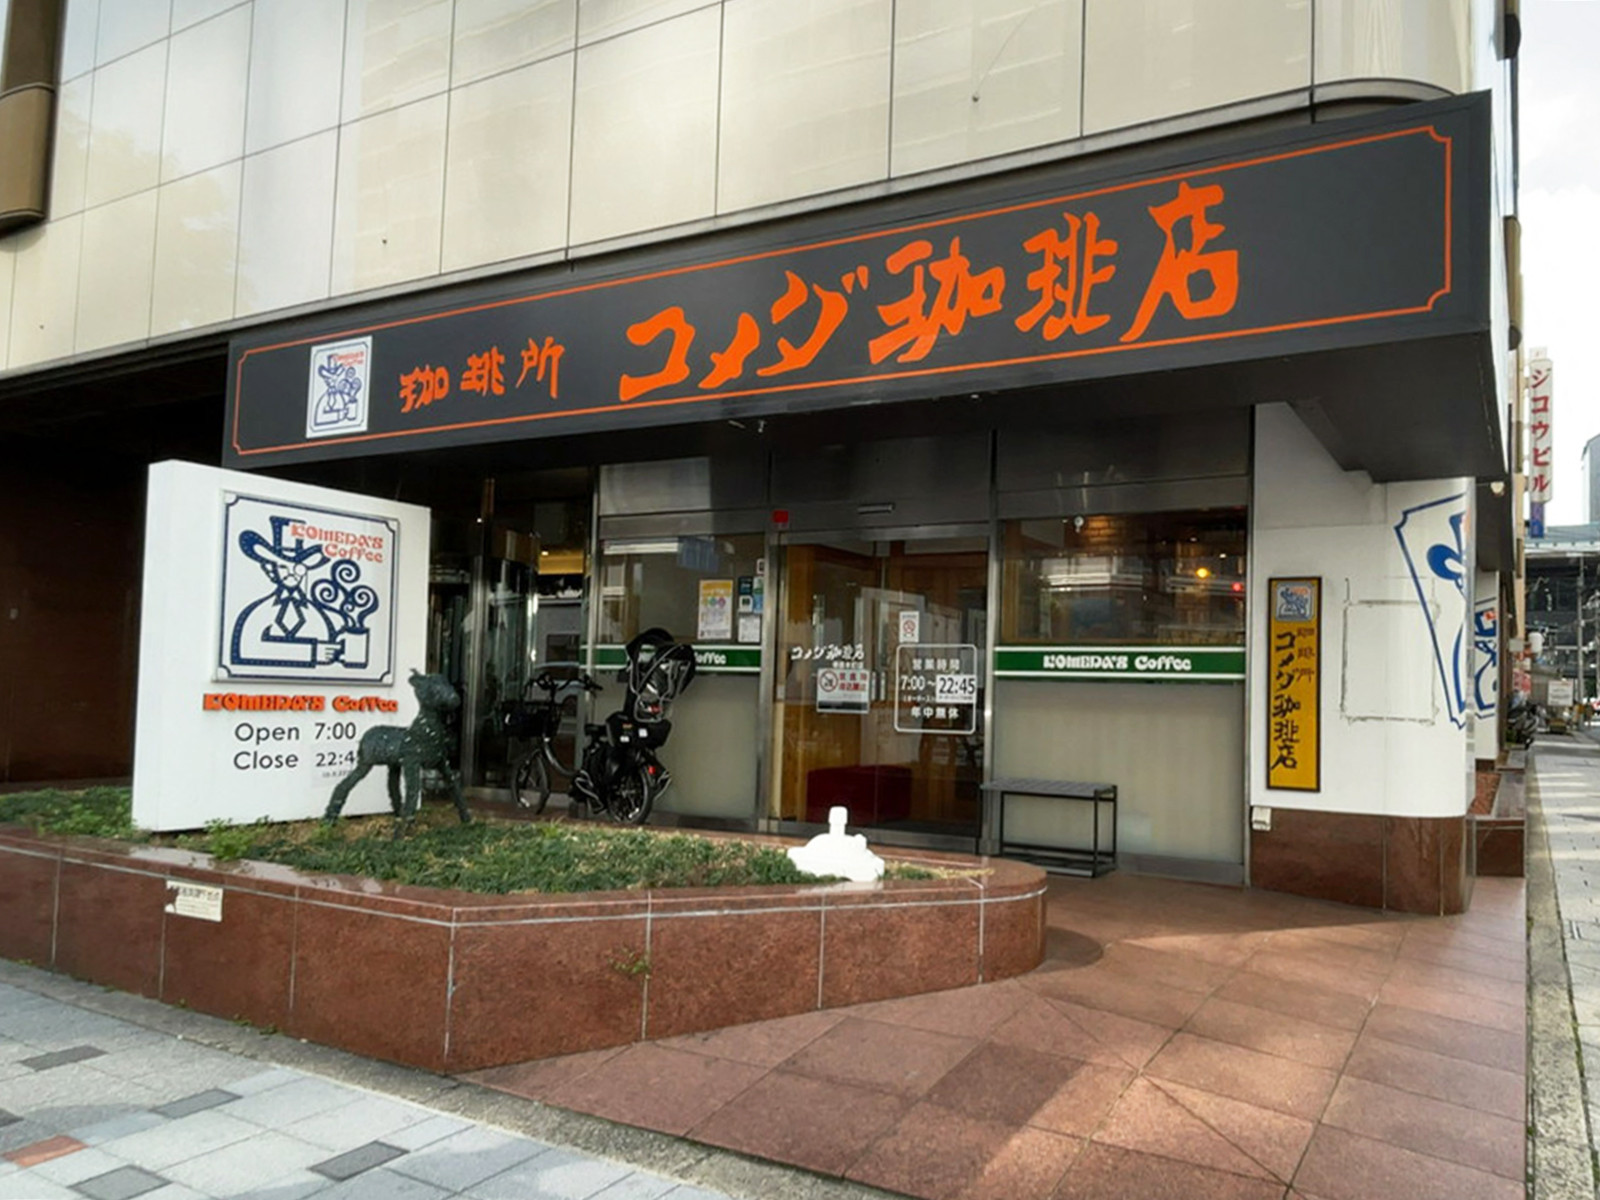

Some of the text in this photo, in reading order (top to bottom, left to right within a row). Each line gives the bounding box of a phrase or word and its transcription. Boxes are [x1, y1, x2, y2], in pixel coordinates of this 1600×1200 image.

[399, 180, 1240, 414] 珈琲所 コメダ珈琲店
[290, 524, 384, 549] KOMEDA'S
[324, 542, 384, 563] Coffee
[1042, 654, 1192, 671] KOMEDA'S Coffee
[938, 676, 976, 694] 22:45
[203, 693, 399, 712] KOMEDA'S Coffee
[234, 722, 357, 746] Open 7:00
[233, 751, 357, 770] Close 22:4
